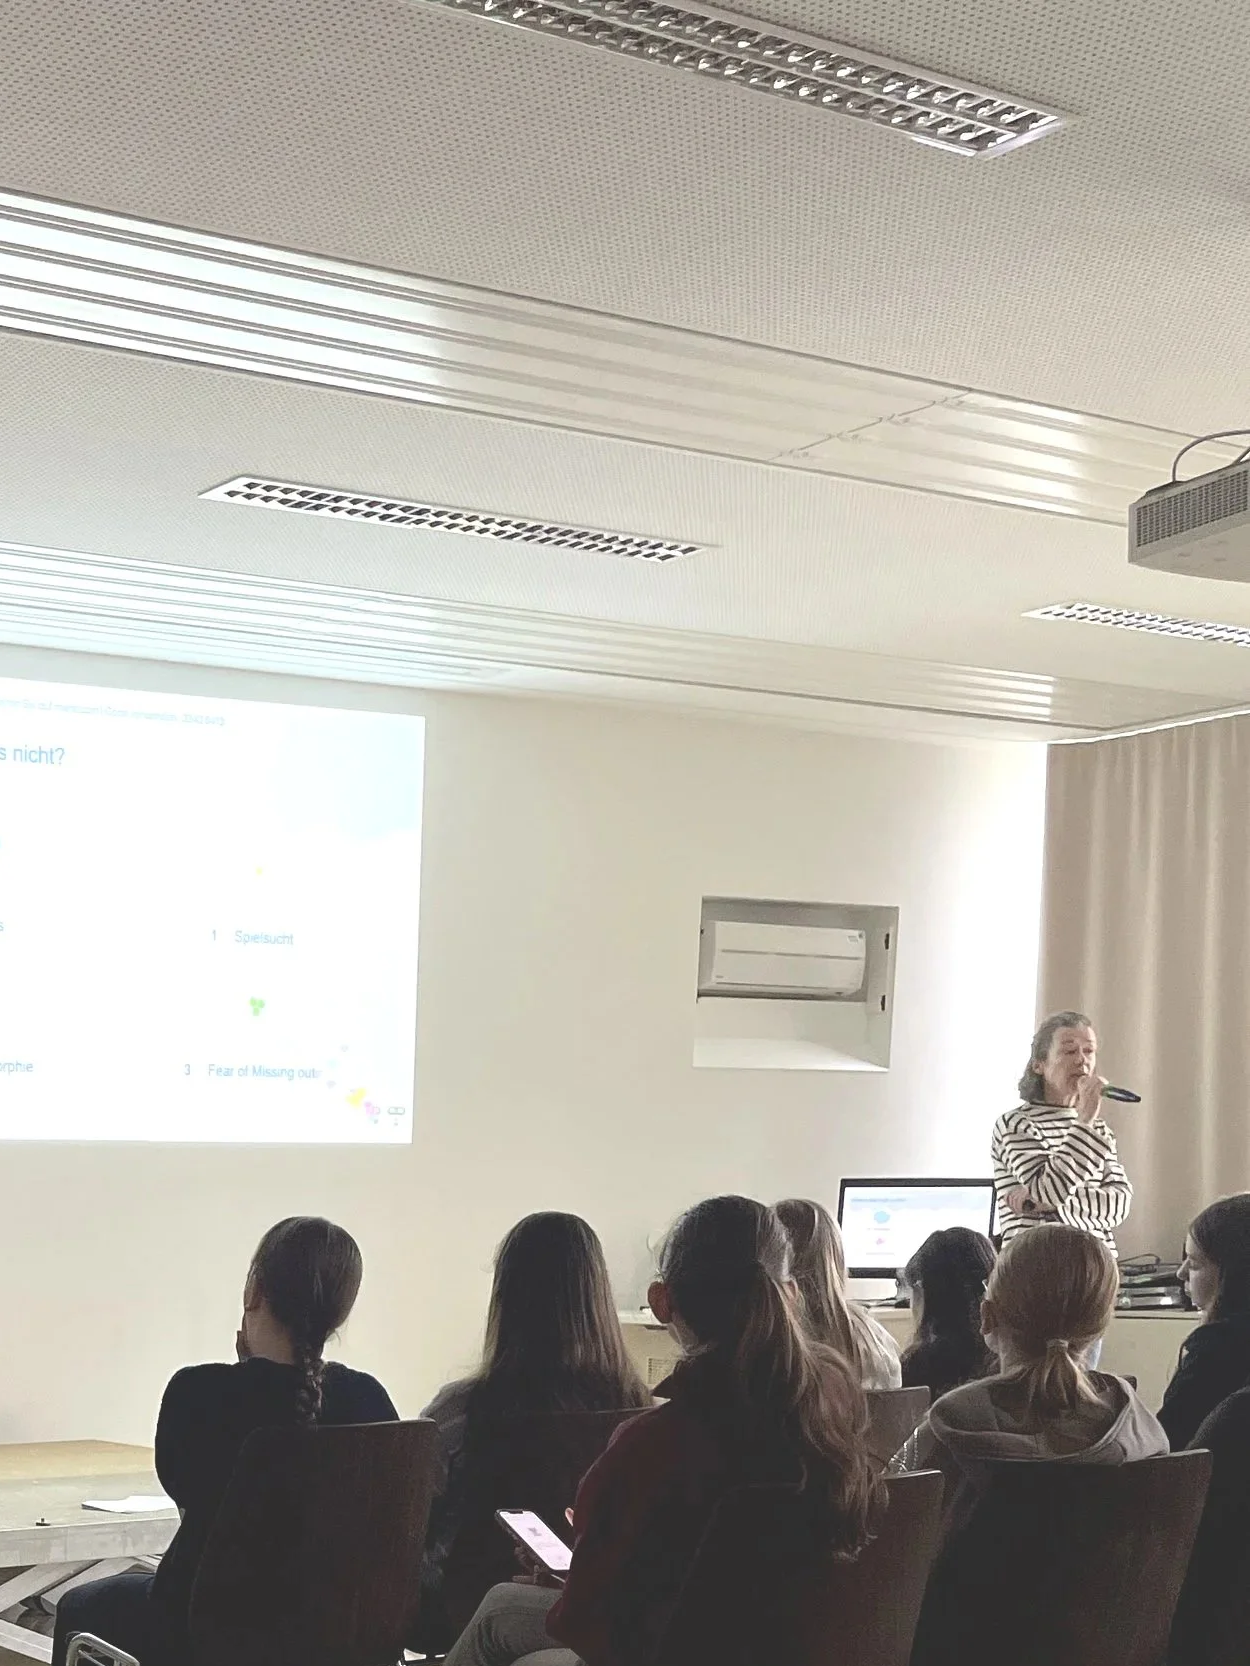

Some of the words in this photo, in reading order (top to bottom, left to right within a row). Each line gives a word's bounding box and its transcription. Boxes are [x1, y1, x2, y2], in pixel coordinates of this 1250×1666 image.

[12, 741, 65, 767] nicht?
[234, 929, 294, 947] Spielsucht
[183, 1063, 191, 1077] 3
[207, 1063, 234, 1077] Fear
[237, 1064, 249, 1077] of
[252, 1065, 295, 1081] Missing
